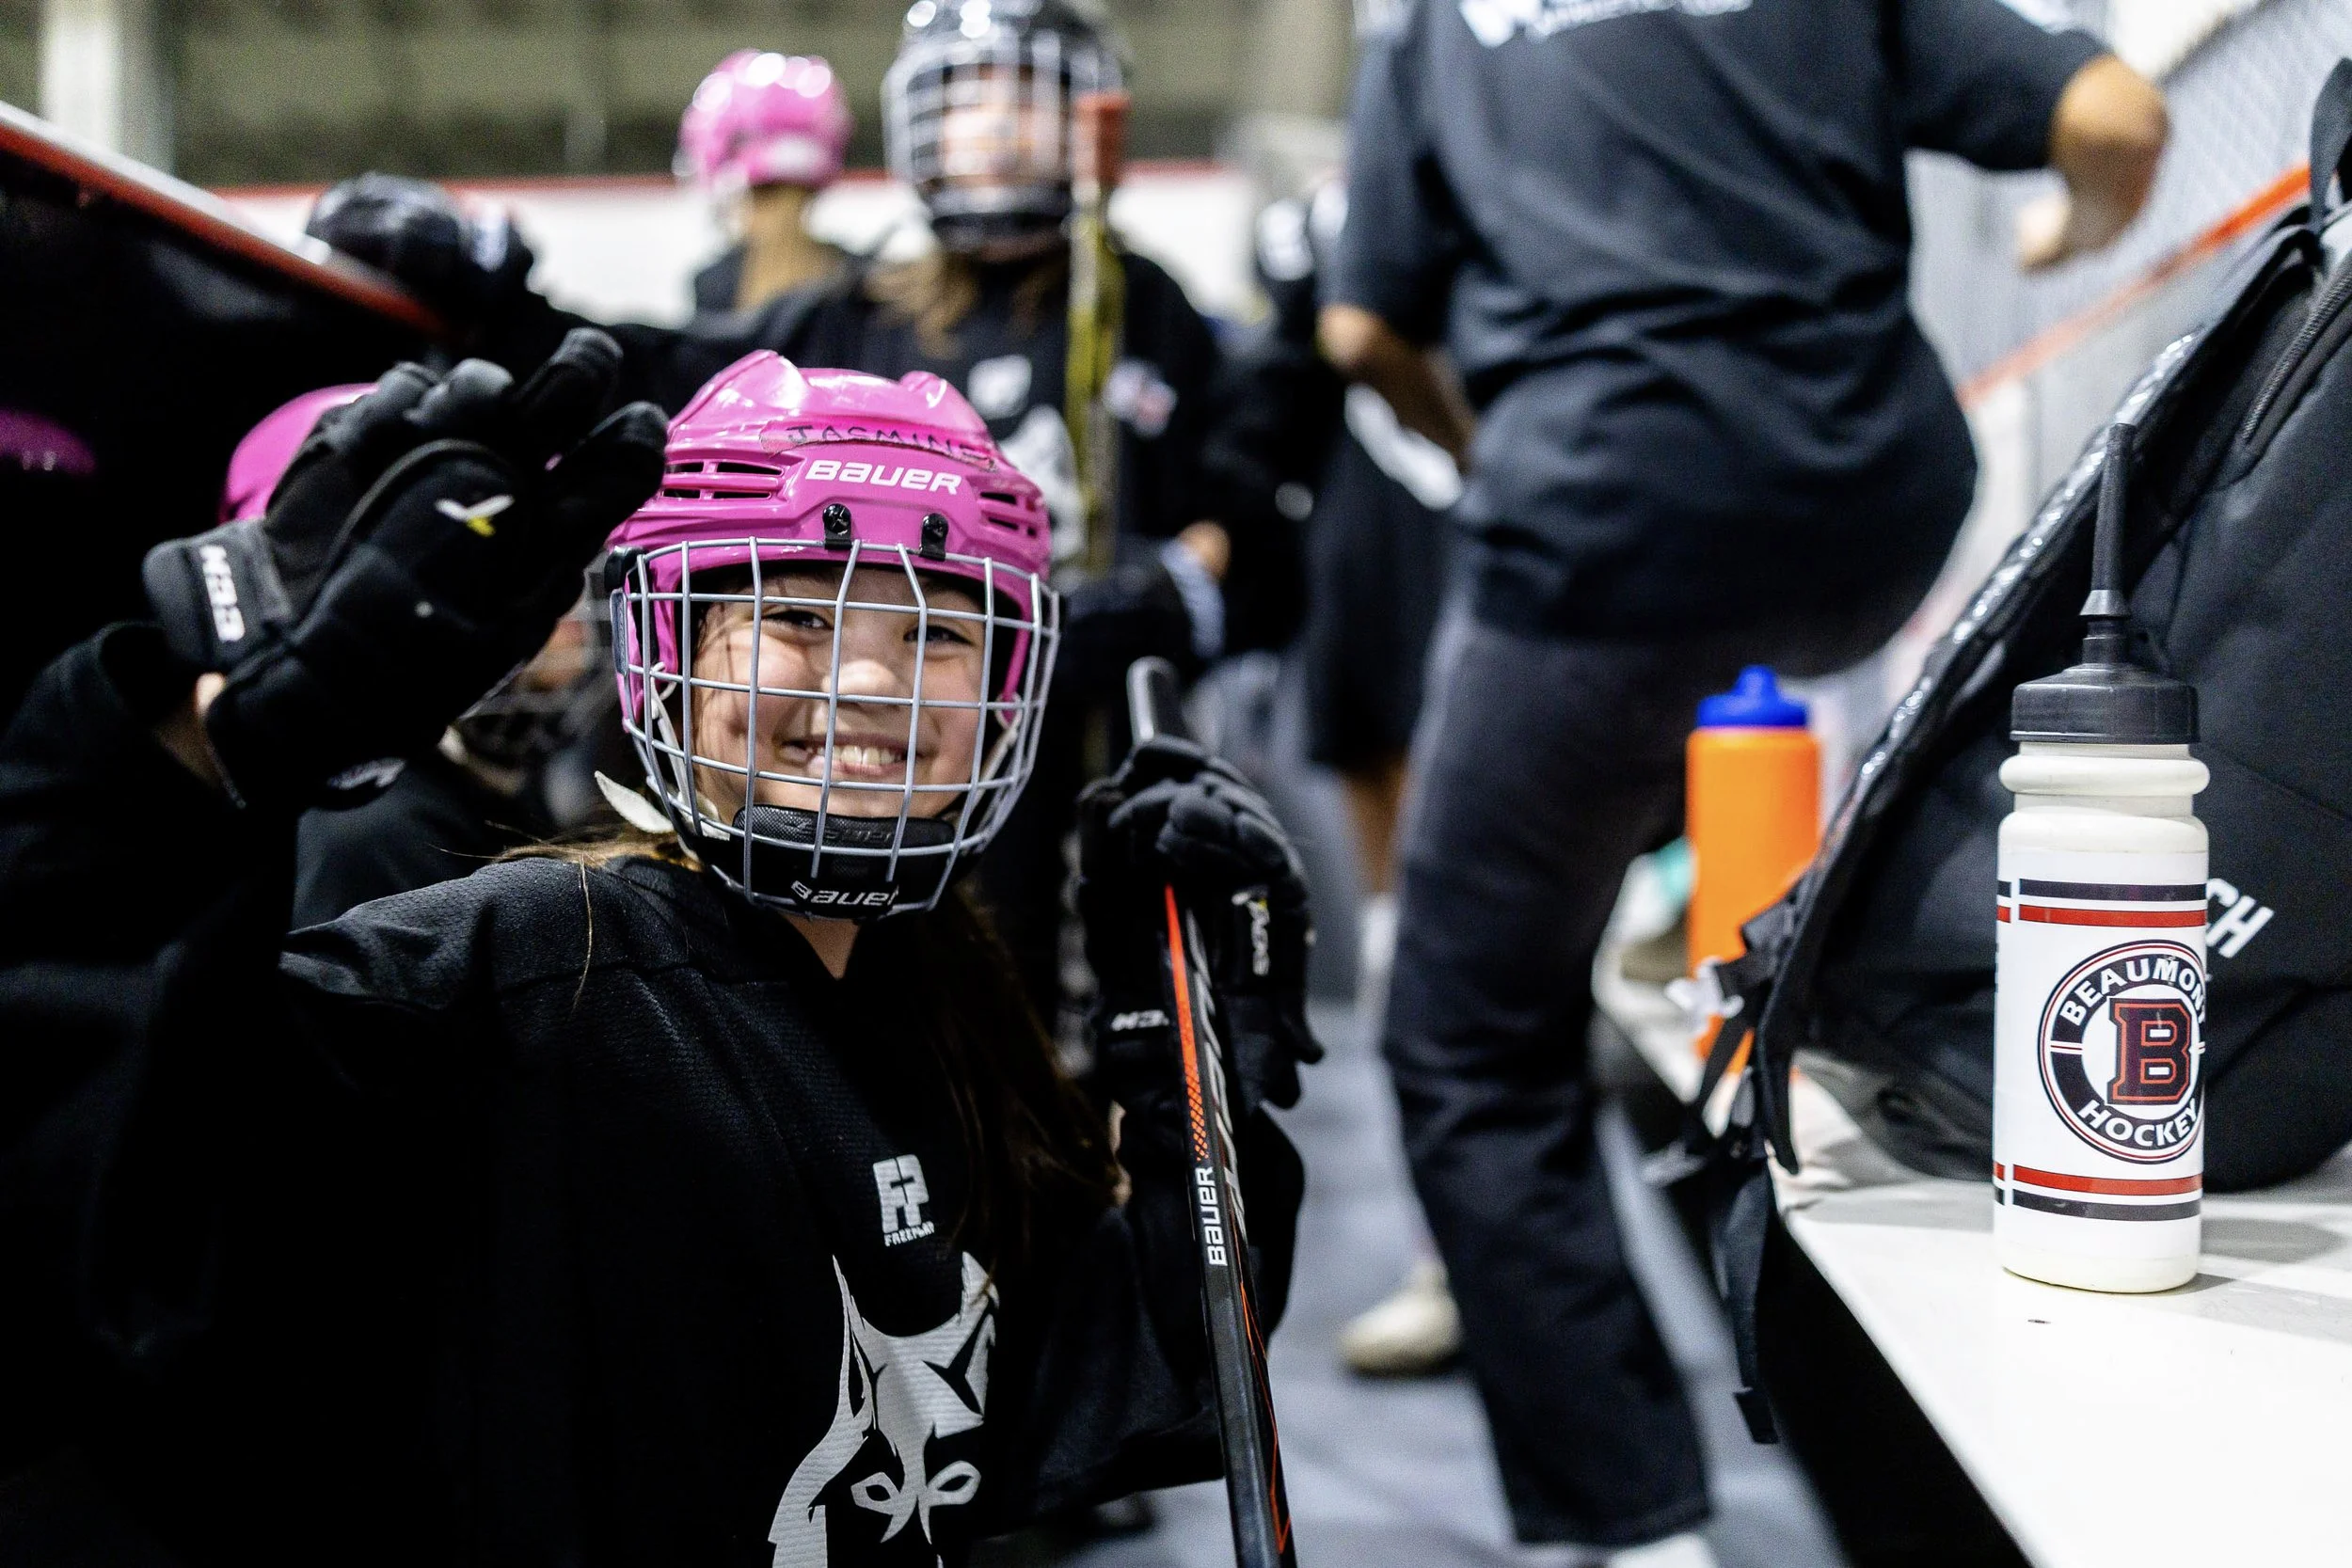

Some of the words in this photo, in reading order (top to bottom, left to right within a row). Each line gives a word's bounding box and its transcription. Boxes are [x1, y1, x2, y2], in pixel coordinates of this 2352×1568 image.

[805, 459, 962, 496] BAUER
[2076, 1098, 2198, 1148] HOCKEY
[1196, 1165, 1228, 1267] BAUER
